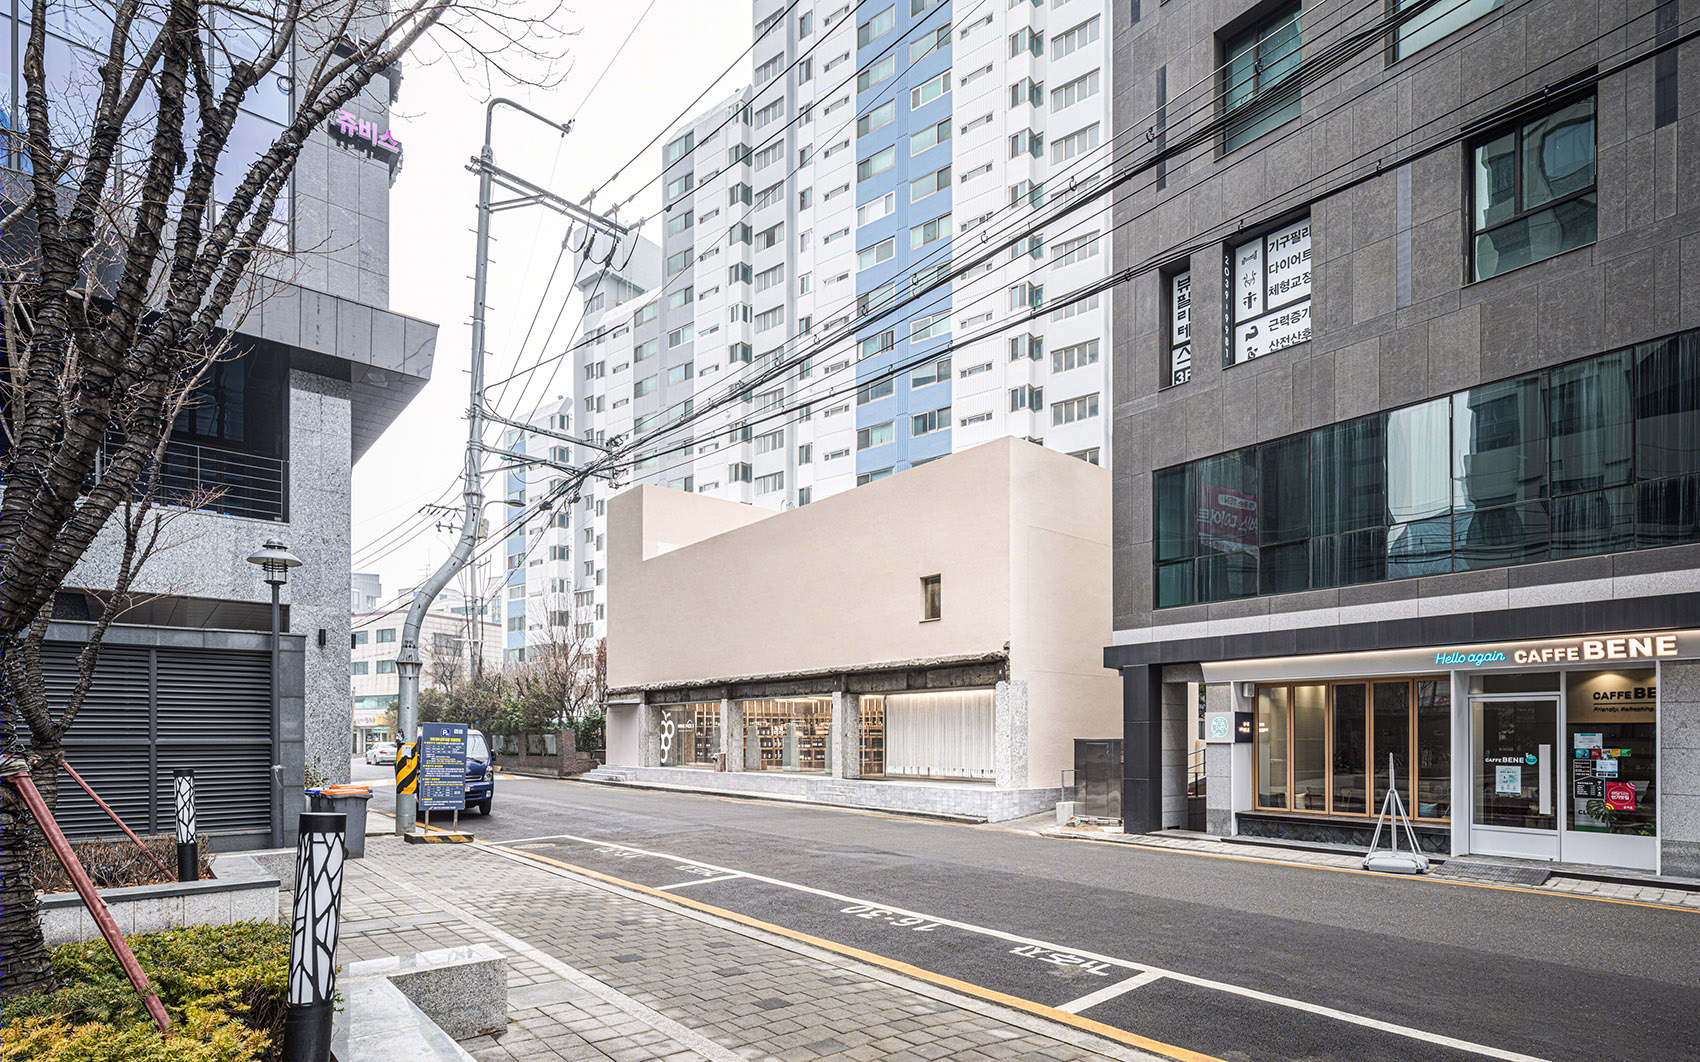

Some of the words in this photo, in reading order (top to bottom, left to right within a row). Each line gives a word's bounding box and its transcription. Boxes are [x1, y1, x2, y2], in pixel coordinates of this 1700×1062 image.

[336, 109, 399, 153] 쥬비스
[1268, 249, 1312, 274] 다이어트
[1268, 272, 1312, 297] 체형교정
[1223, 255, 1231, 358] 2039-9981
[1268, 328, 1312, 352] 산전산후
[1435, 651, 1466, 665] Hello
[1466, 650, 1506, 667] again
[1513, 646, 1579, 664] CAFFE
[1582, 635, 1679, 661] BENE
[1593, 691, 1632, 700] CAFFE
[1008, 944, 1113, 977] 거주자
